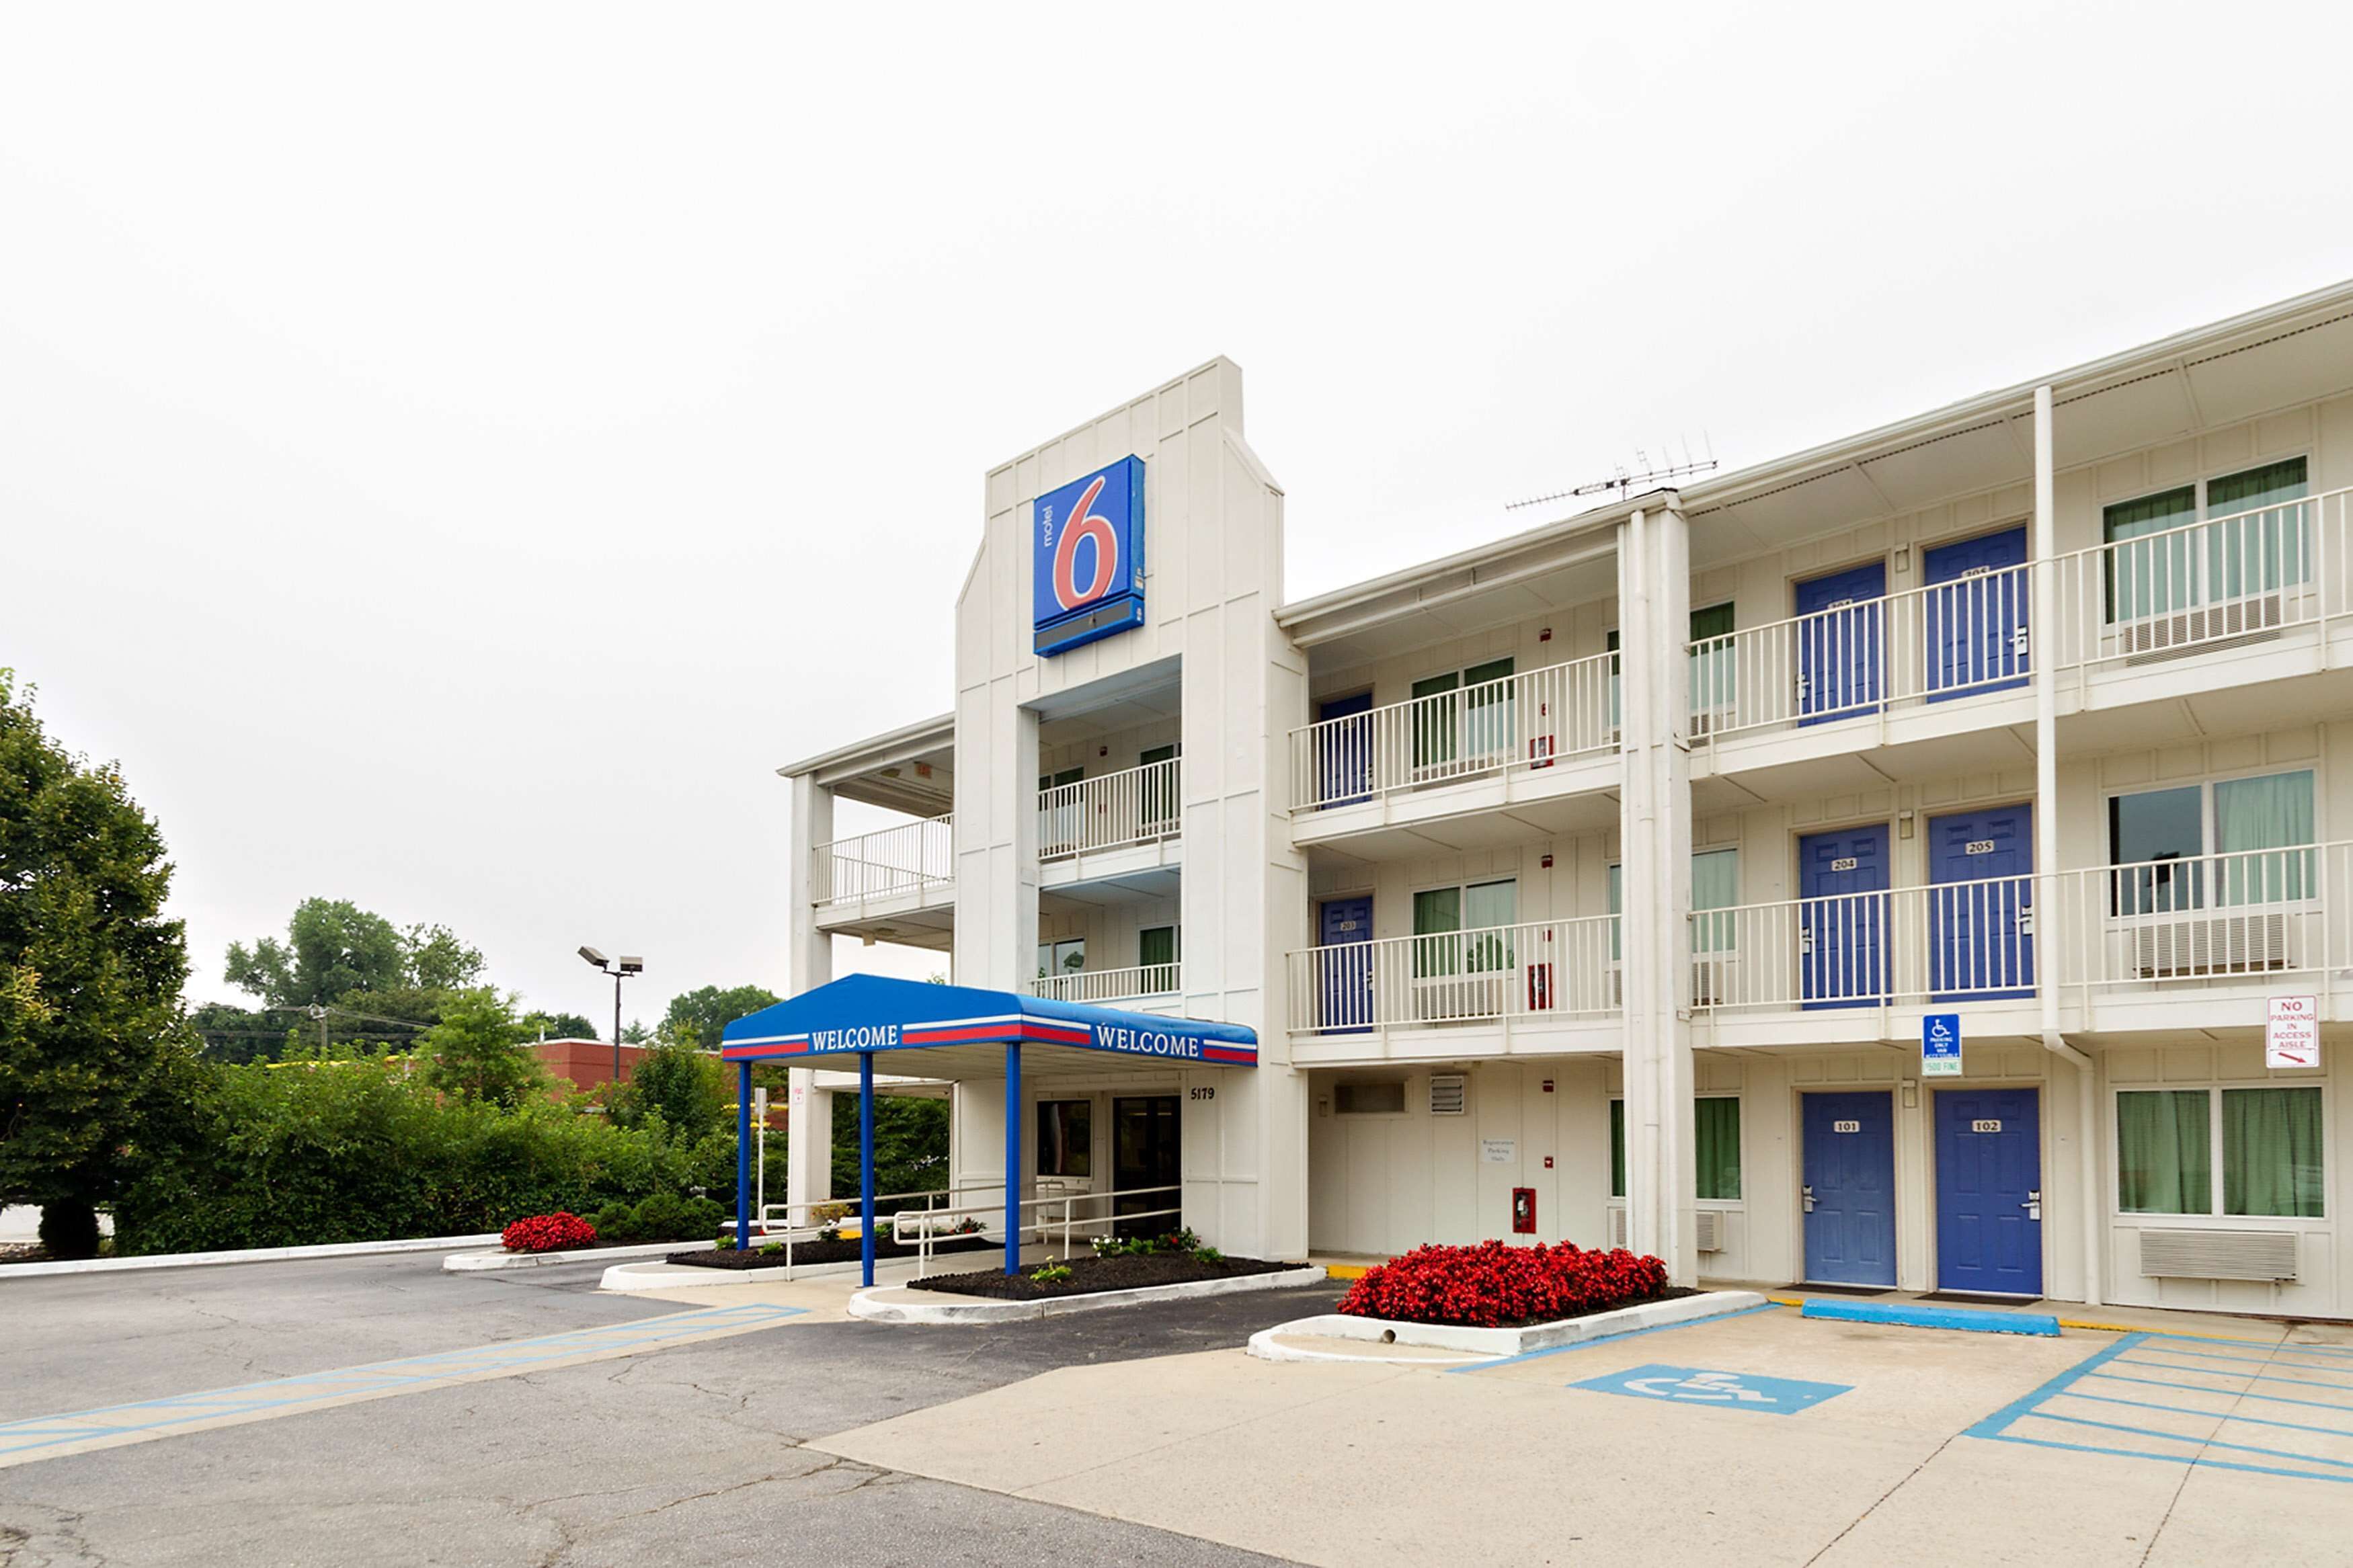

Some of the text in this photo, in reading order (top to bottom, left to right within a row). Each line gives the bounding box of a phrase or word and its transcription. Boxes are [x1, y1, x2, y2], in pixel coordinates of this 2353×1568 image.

[1043, 475, 1119, 611] motel 6
[1969, 841, 1992, 852] 205
[1835, 859, 1855, 870] 204
[2281, 1001, 2303, 1011] NO
[812, 1025, 898, 1050] WELCOME
[1096, 1024, 1199, 1057] WELCOME
[1191, 1087, 1215, 1100] 5179
[1838, 1122, 1856, 1131] 101
[1975, 1121, 1999, 1130] 102
